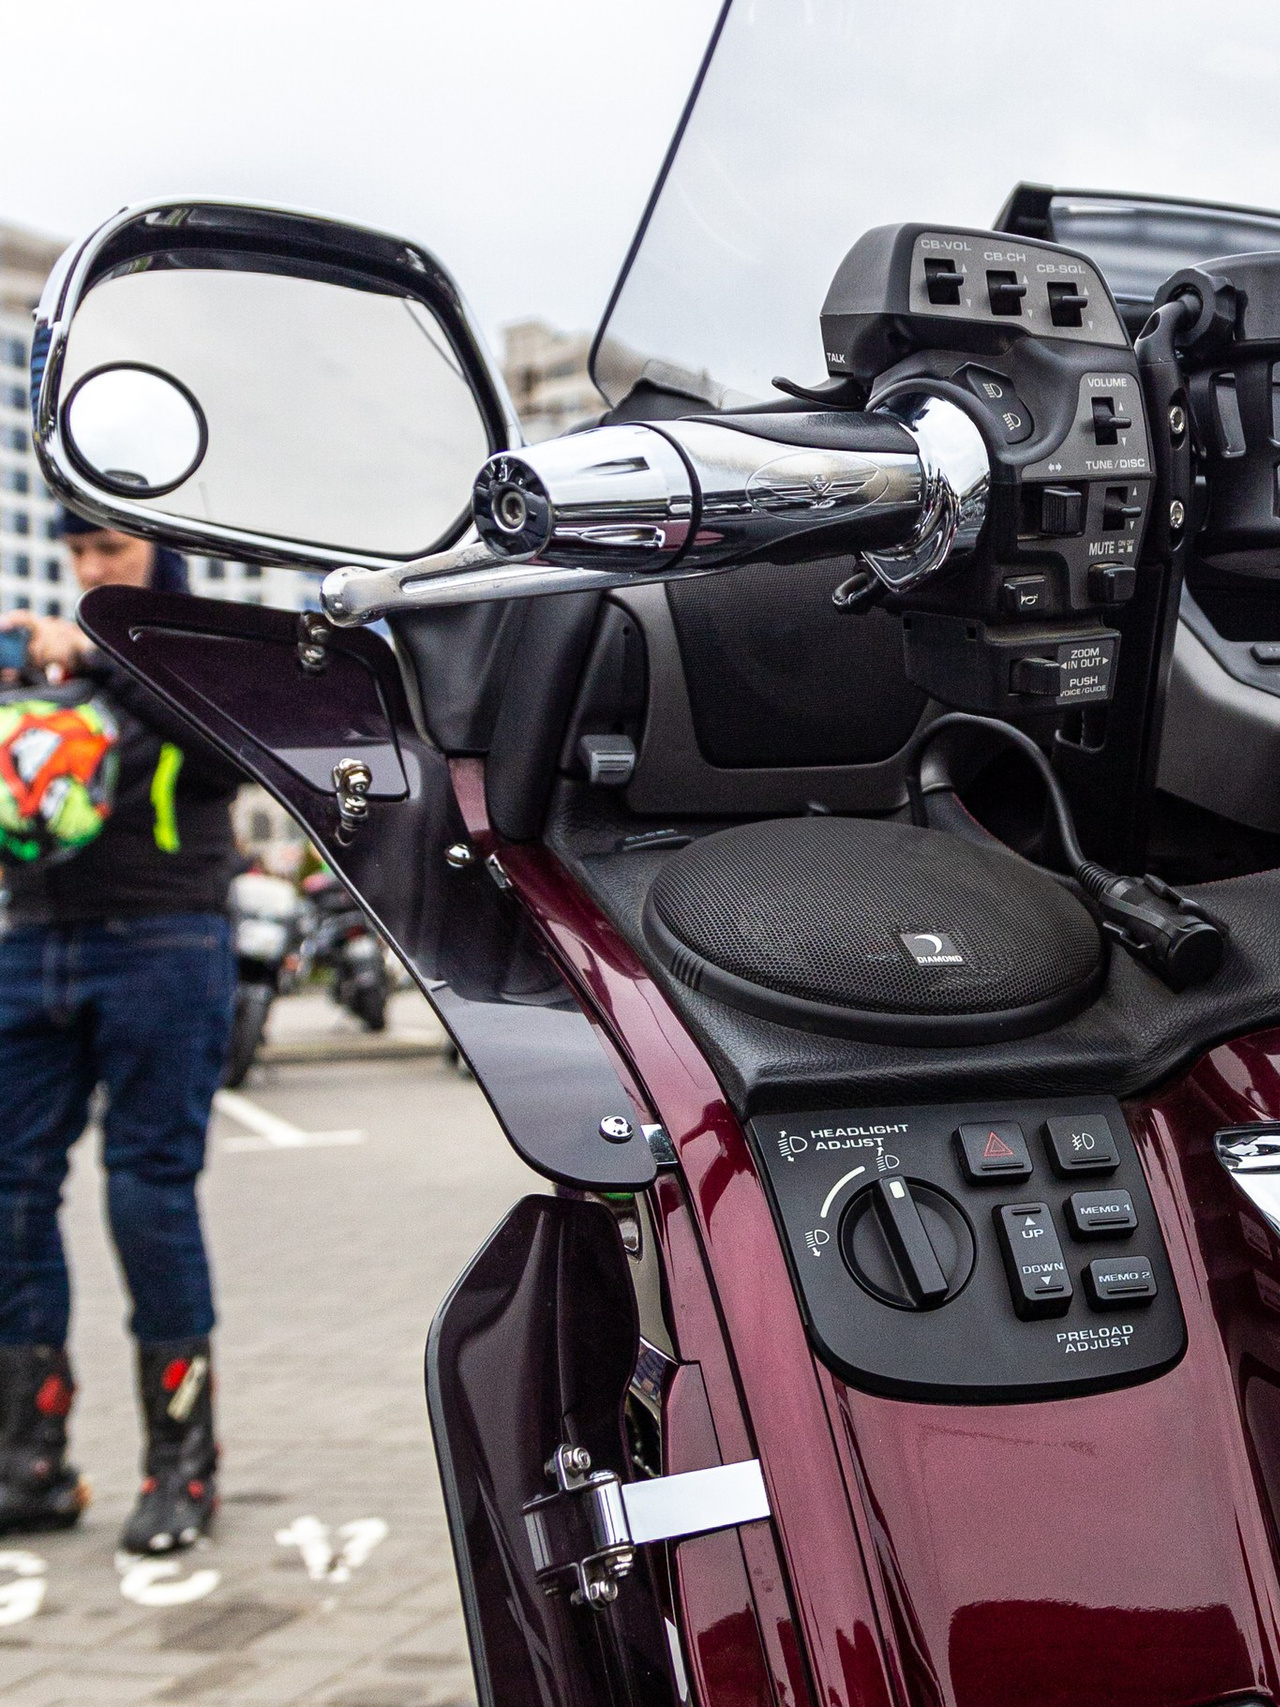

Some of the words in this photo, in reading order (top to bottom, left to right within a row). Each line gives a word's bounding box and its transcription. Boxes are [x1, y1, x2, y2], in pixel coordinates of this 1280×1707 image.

[920, 239, 972, 251] CB-VOL
[983, 251, 1027, 263] CB-CH
[1036, 263, 1086, 275] CB-SQL
[826, 352, 846, 364] TALK
[1087, 378, 1128, 387] VOLUME
[1085, 458, 1145, 470] TUNE/DISC
[1088, 541, 1116, 556] MUTE
[1071, 647, 1100, 658] ZOOM
[1067, 660, 1078, 669] IN
[1081, 657, 1101, 668] OUT
[1069, 675, 1099, 687] PUSH
[1060, 685, 1107, 697] VOICE/GUIDE
[916, 955, 963, 964] DIAMOND
[810, 1123, 909, 1140] HEADLIGHT
[815, 1138, 884, 1151] ADJUST
[1080, 1204, 1120, 1215] MEMO
[1123, 1203, 1131, 1212] 1
[1021, 1228, 1044, 1239] UP
[1022, 1261, 1065, 1275] DOWN
[1098, 1272, 1139, 1284] MEMO
[1141, 1271, 1151, 1280] 2
[1056, 1324, 1135, 1343] PRELOAD
[1064, 1336, 1131, 1354] ADJUST
